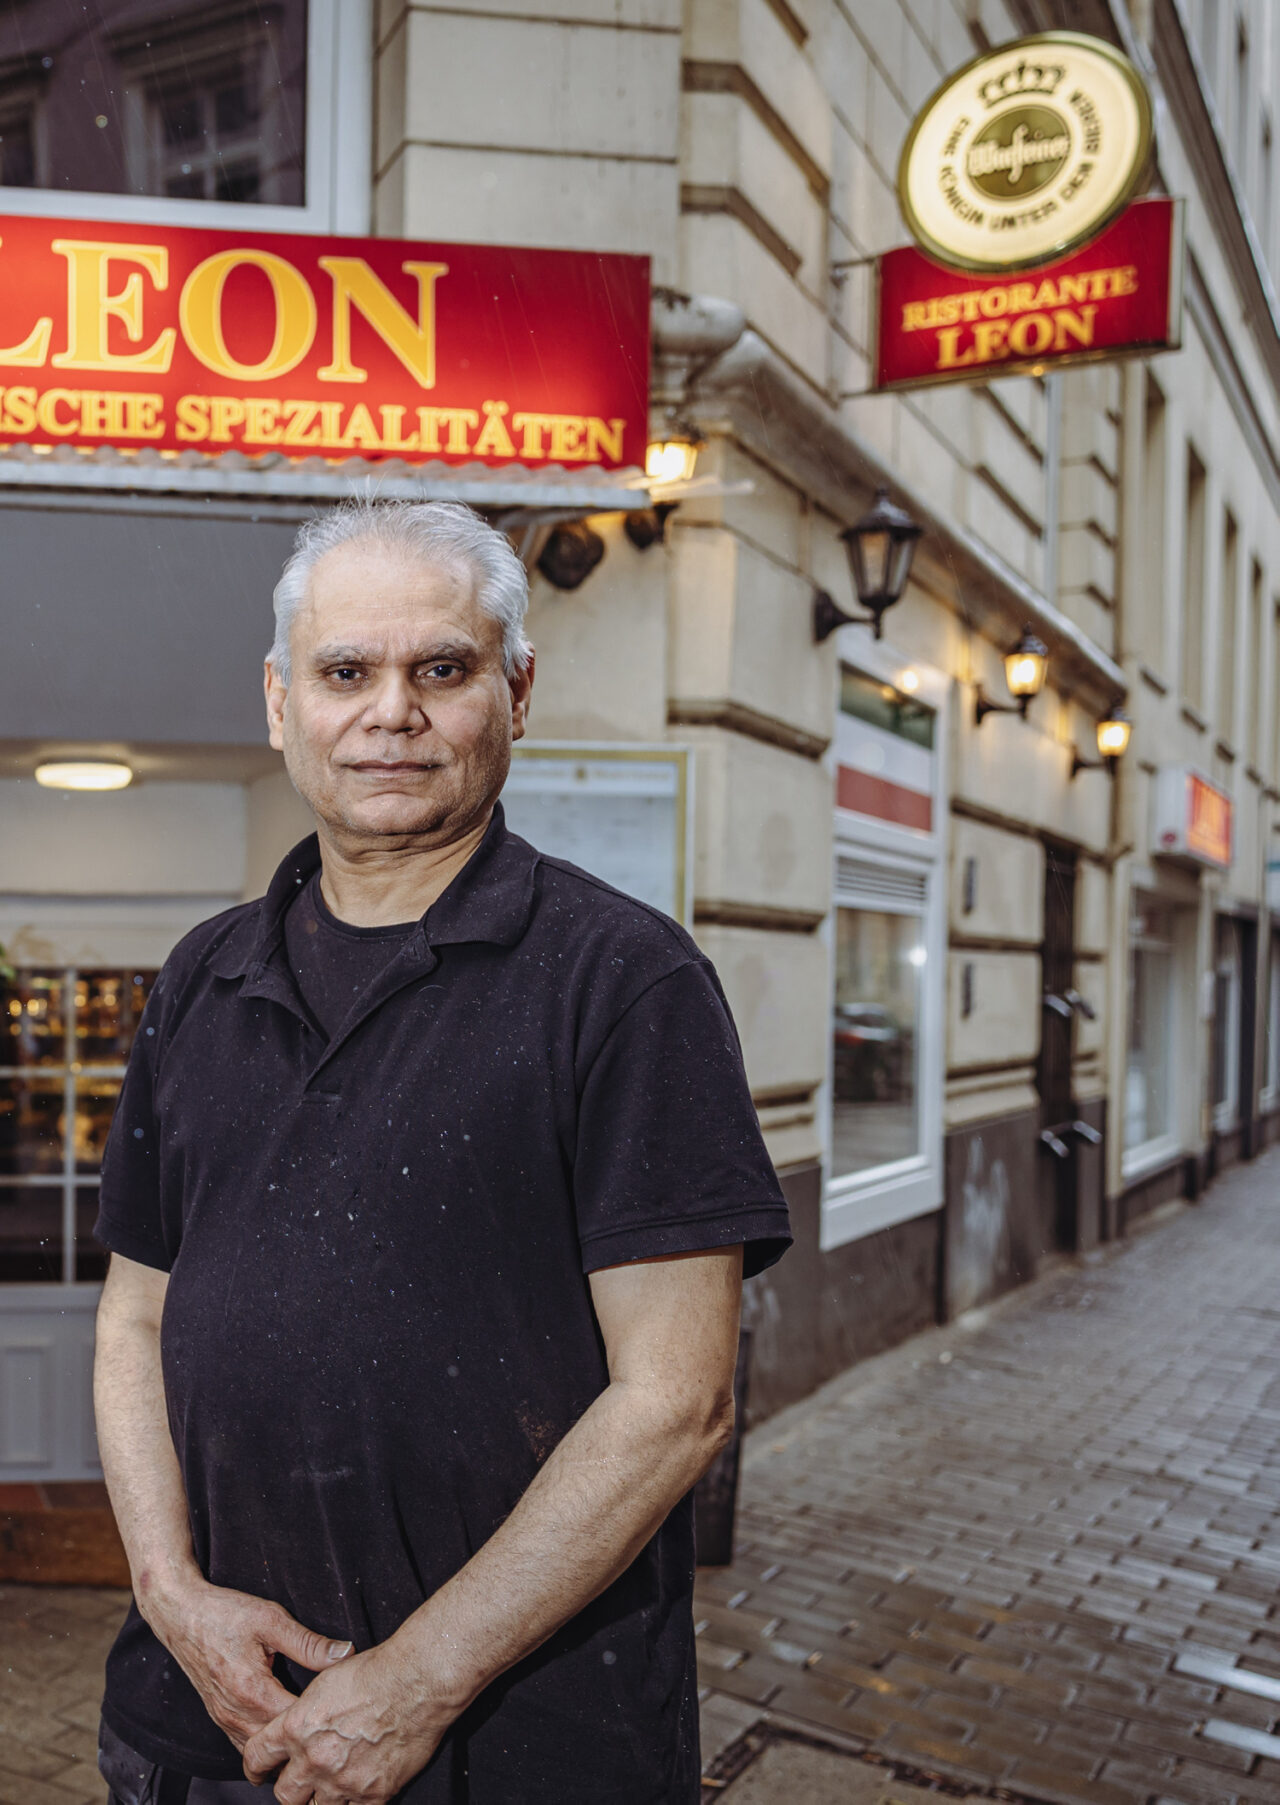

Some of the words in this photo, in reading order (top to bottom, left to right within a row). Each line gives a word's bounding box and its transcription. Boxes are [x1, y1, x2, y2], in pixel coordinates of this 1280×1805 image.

[902, 265, 1138, 332] RISTORANTE
[936, 304, 1099, 369] LEON
[176, 392, 627, 466] SPEZIALITÄTEN
